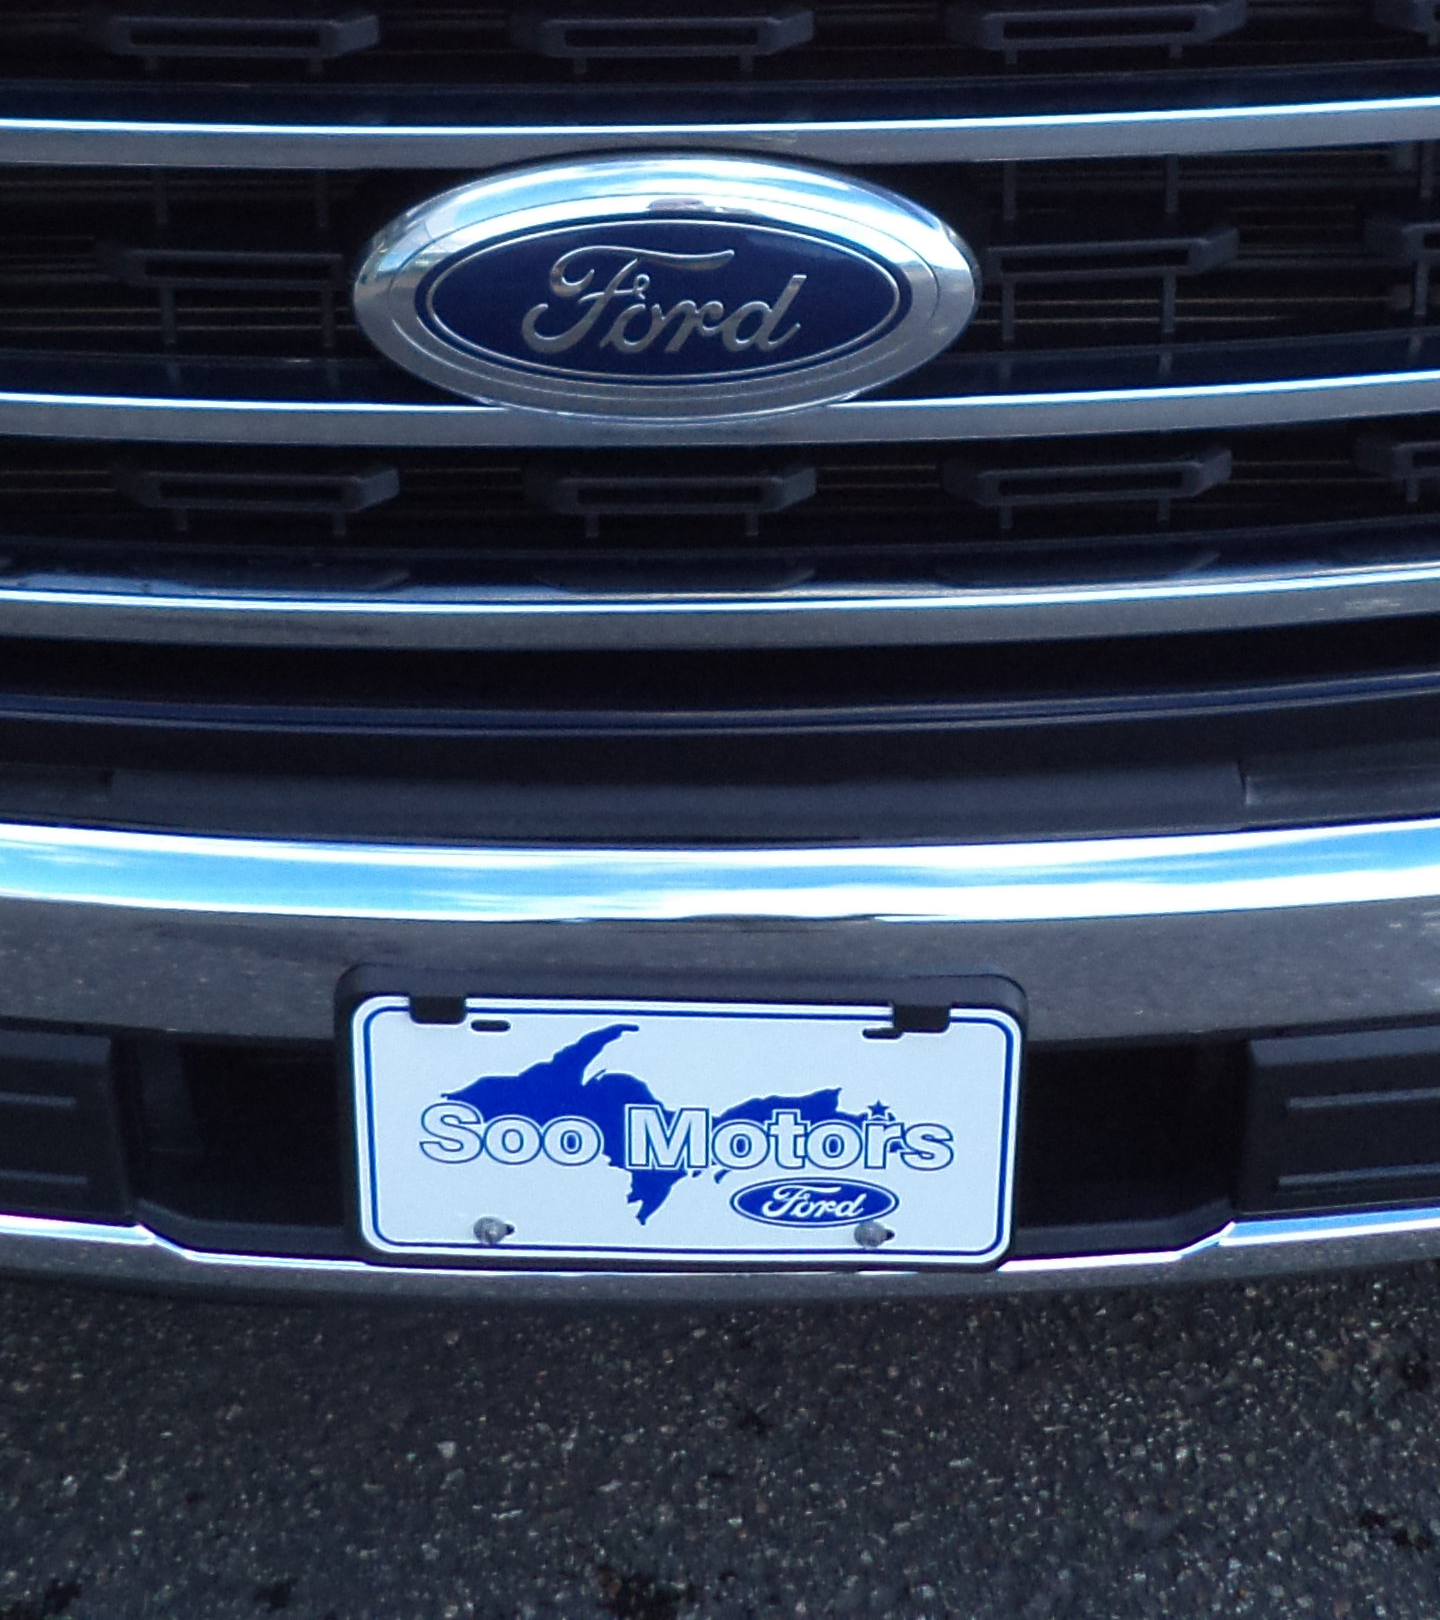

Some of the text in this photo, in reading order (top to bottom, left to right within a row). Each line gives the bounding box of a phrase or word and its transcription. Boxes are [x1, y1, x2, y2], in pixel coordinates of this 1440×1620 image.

[522, 245, 808, 354] Ford
[419, 1102, 955, 1170] Soo Motors
[761, 1185, 865, 1219] Ford
